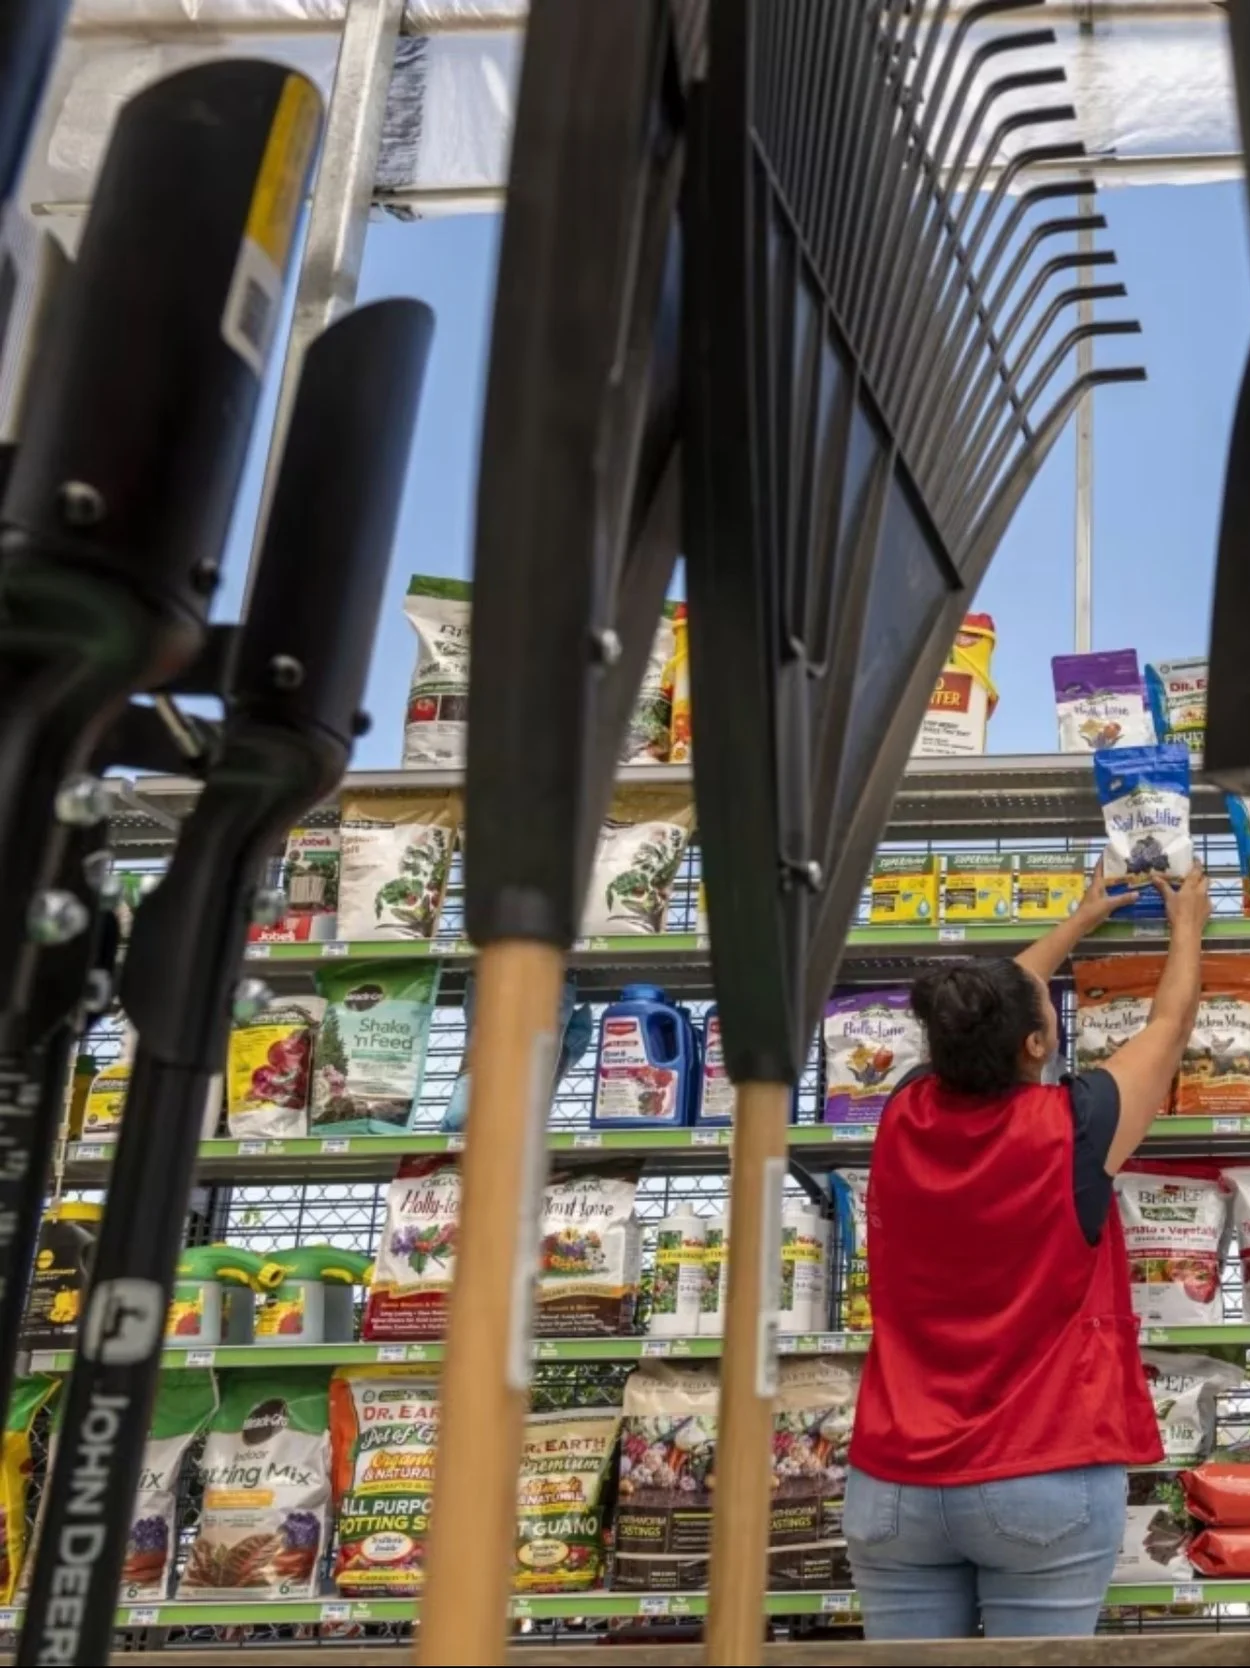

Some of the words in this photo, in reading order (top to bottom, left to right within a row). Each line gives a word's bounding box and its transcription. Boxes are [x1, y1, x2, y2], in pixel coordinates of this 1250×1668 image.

[358, 1016, 411, 1035] Shake
[370, 1034, 415, 1051] Feed
[363, 1405, 394, 1421] DR.
[1170, 1424, 1194, 1440] Mix
[545, 1436, 606, 1454] EARTH
[66, 1394, 130, 1517] JOHN
[266, 1462, 313, 1487] Mix
[532, 1516, 598, 1537] GUANO
